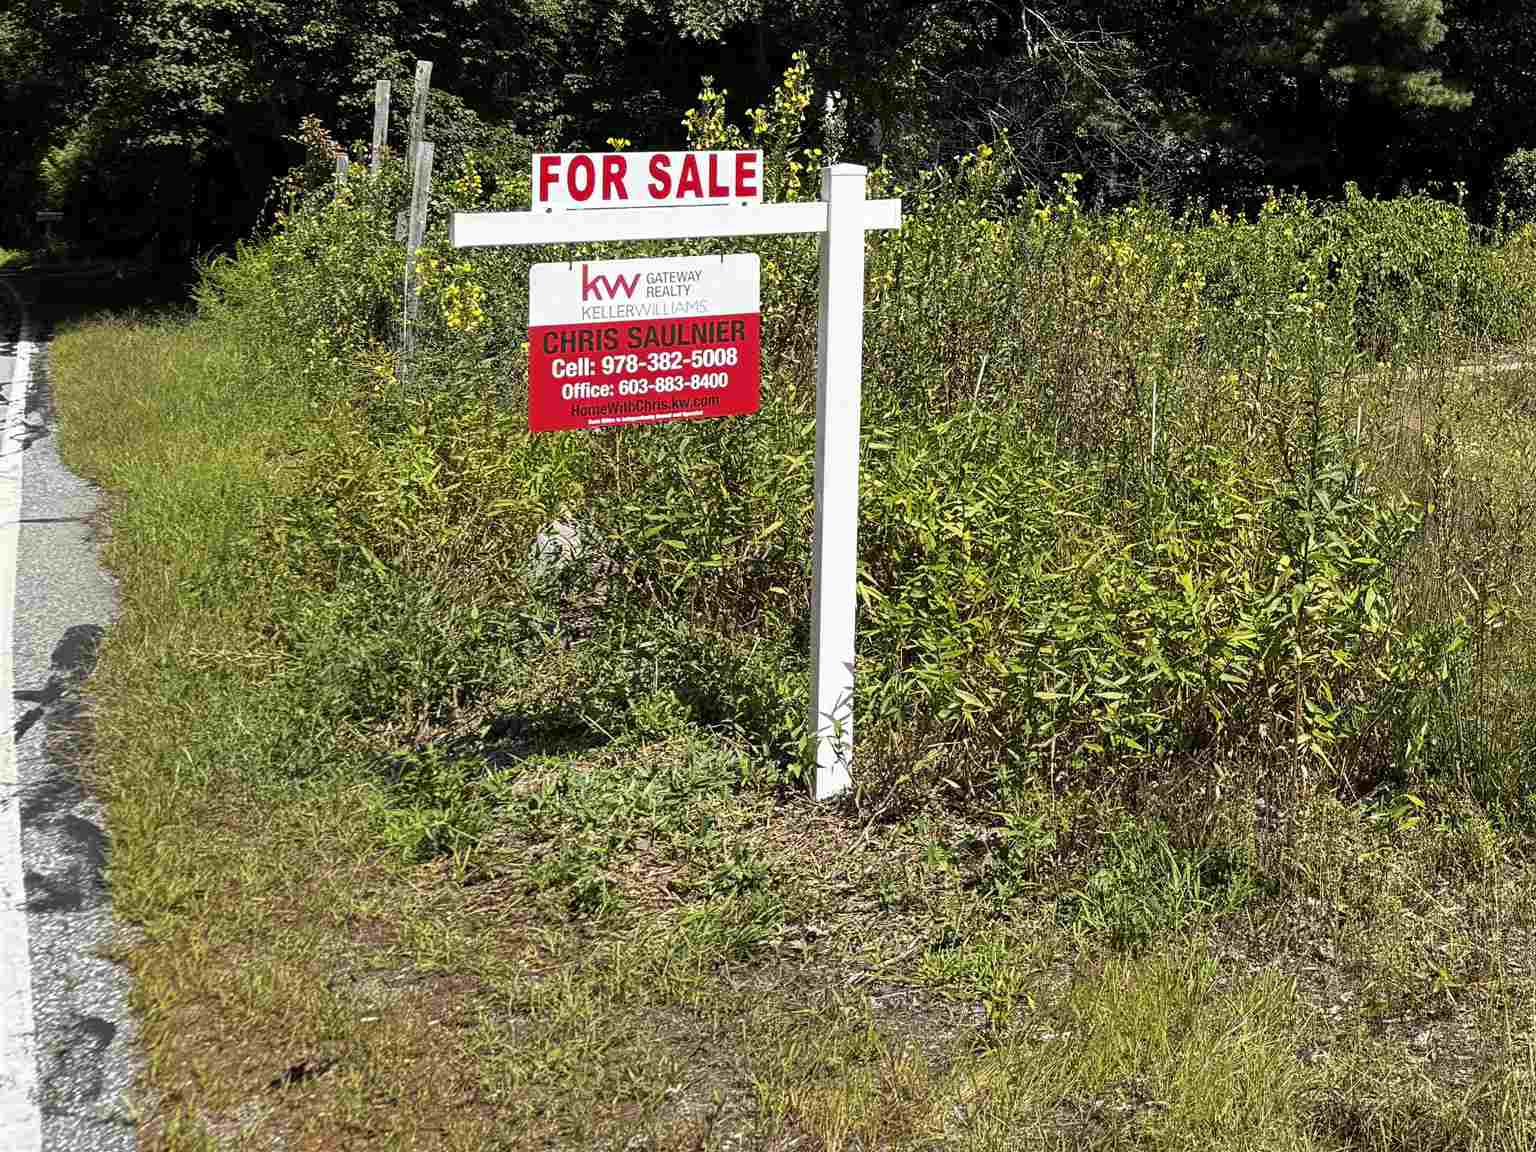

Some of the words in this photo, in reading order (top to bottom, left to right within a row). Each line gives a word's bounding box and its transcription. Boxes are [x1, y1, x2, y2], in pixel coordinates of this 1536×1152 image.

[539, 155, 628, 201] FOR
[648, 153, 757, 199] SALE
[582, 264, 641, 301] kw
[646, 270, 702, 285] GATEWAY
[646, 284, 691, 297] REALTY
[543, 327, 620, 354] CHRIS
[627, 320, 746, 349] SAULNIER
[552, 357, 596, 378] Cell:
[602, 348, 738, 375] 978-382-5008
[562, 383, 614, 400] Office:
[619, 373, 728, 395] 603-883-8400
